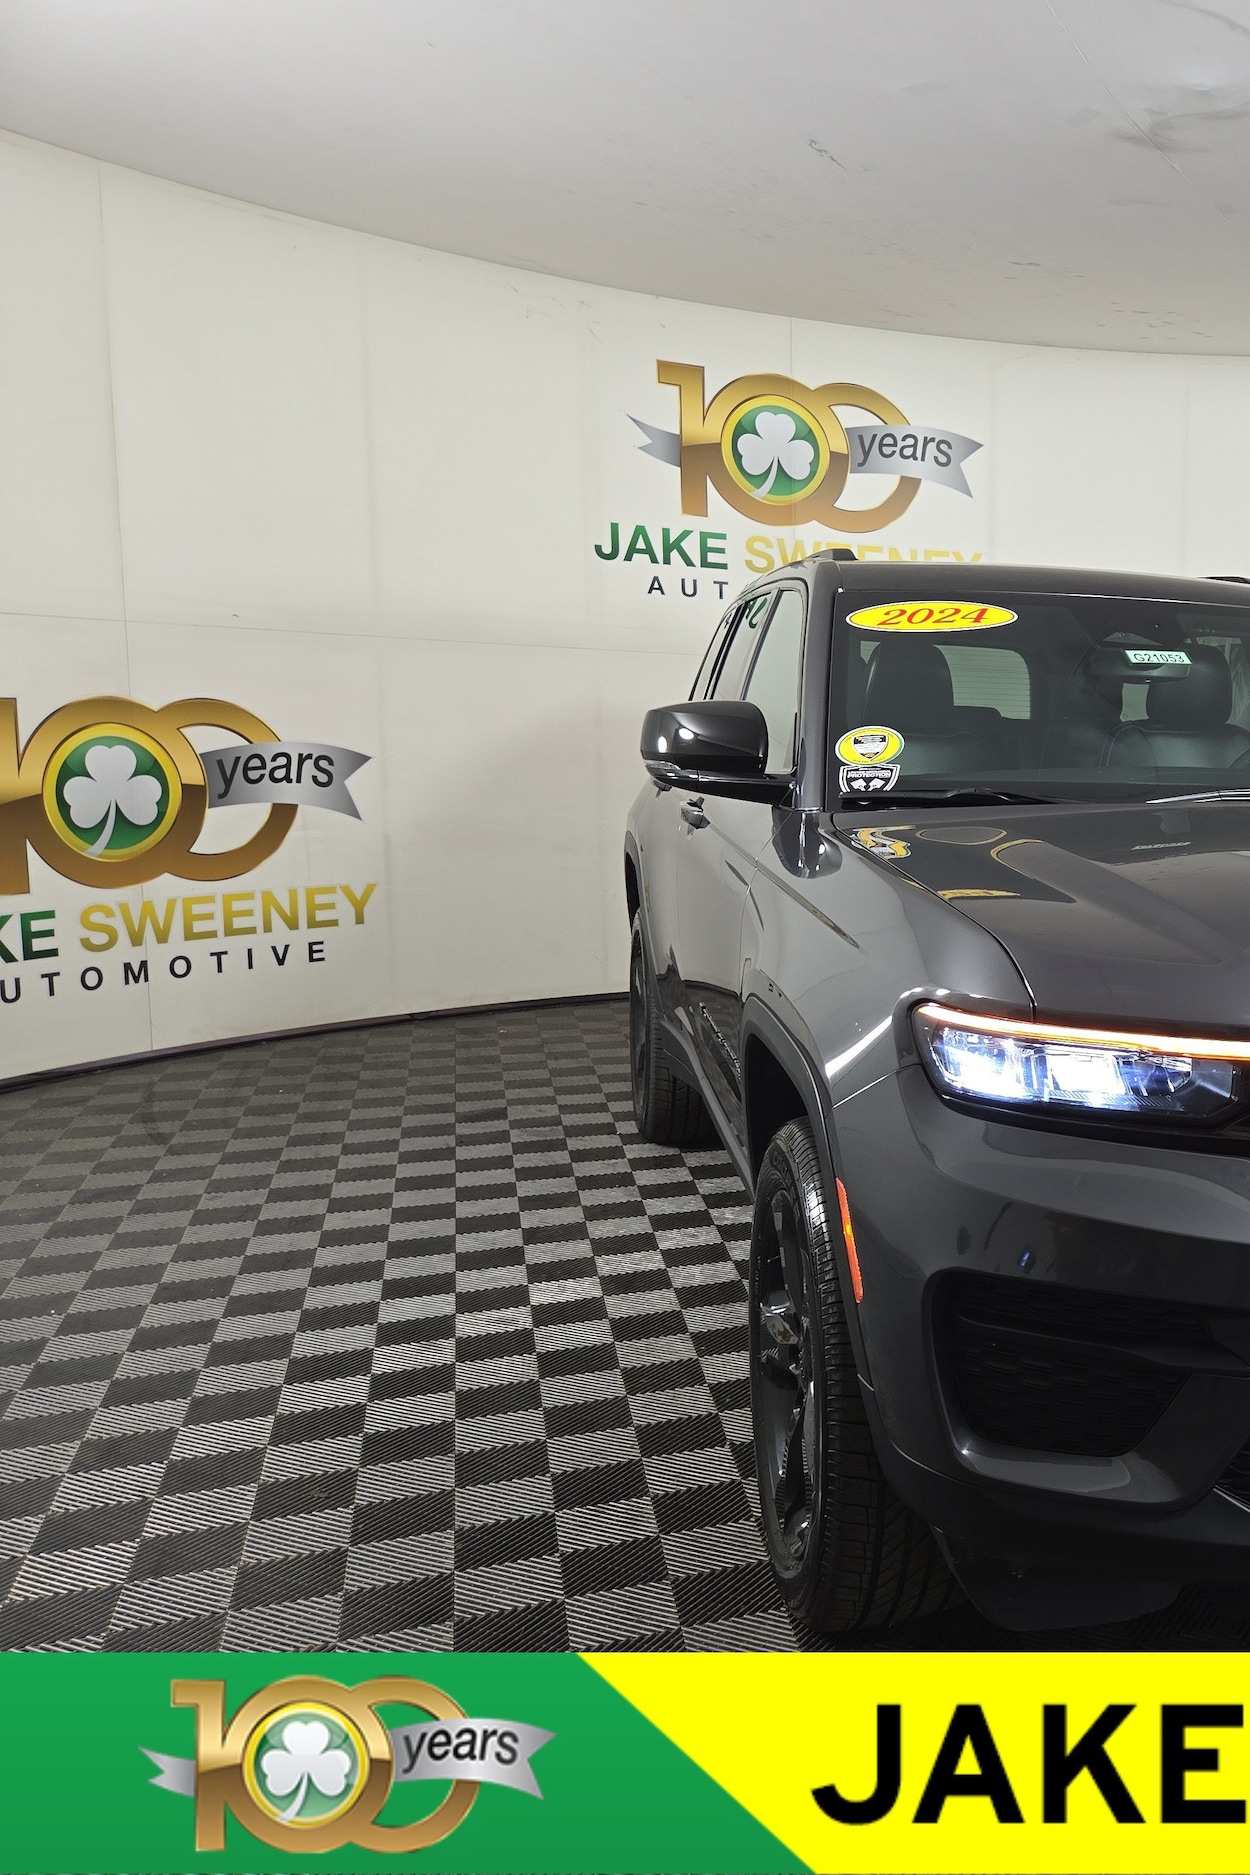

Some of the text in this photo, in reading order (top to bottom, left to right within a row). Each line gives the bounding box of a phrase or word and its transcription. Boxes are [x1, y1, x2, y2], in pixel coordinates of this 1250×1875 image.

[656, 359, 953, 533] 100 years
[594, 522, 729, 571] JAKE
[877, 607, 988, 626] 2024
[1133, 653, 1185, 663] G21053
[216, 751, 335, 799] years
[79, 883, 377, 953] SWEENEY
